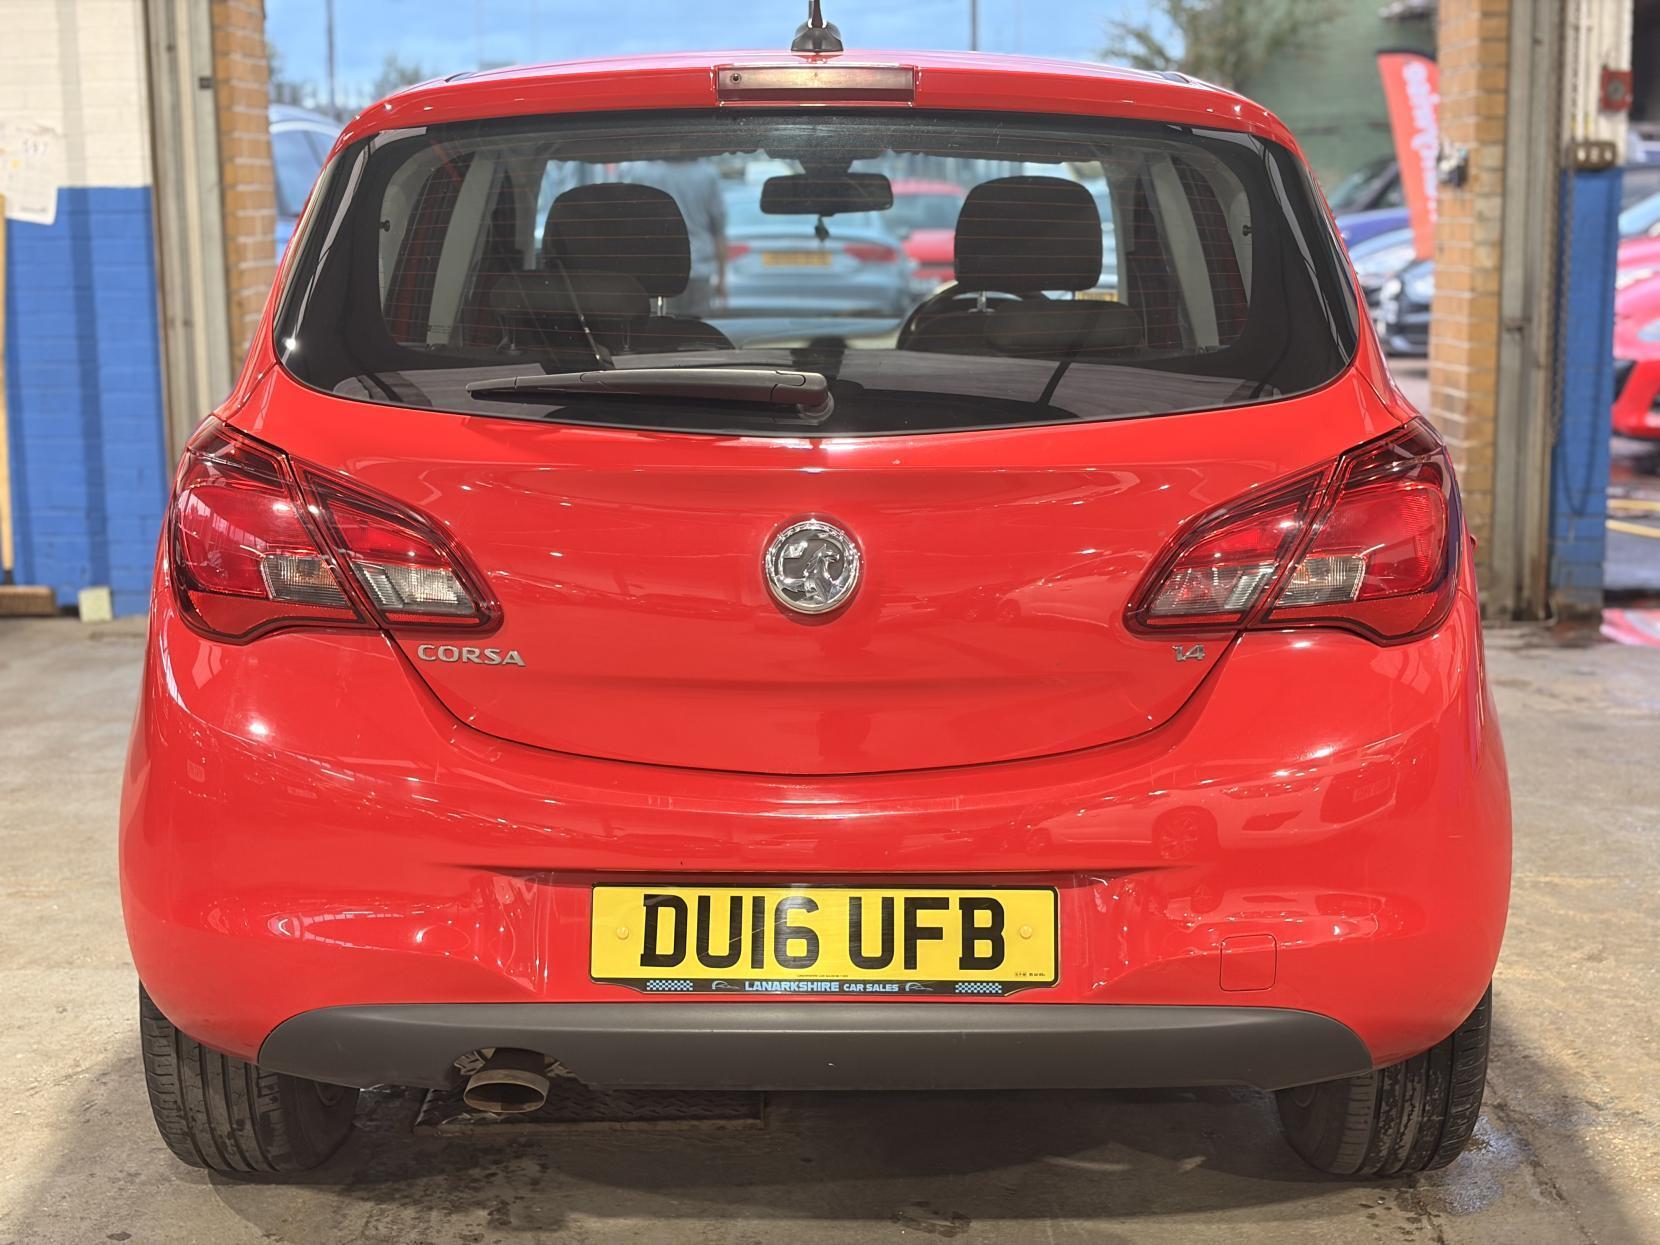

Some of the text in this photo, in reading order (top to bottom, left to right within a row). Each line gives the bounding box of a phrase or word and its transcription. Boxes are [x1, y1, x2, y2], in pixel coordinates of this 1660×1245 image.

[417, 643, 526, 667] CORSA
[640, 893, 1005, 970] DU16 UFB
[744, 981, 899, 992] LANARKSHIRE CAR SALES
